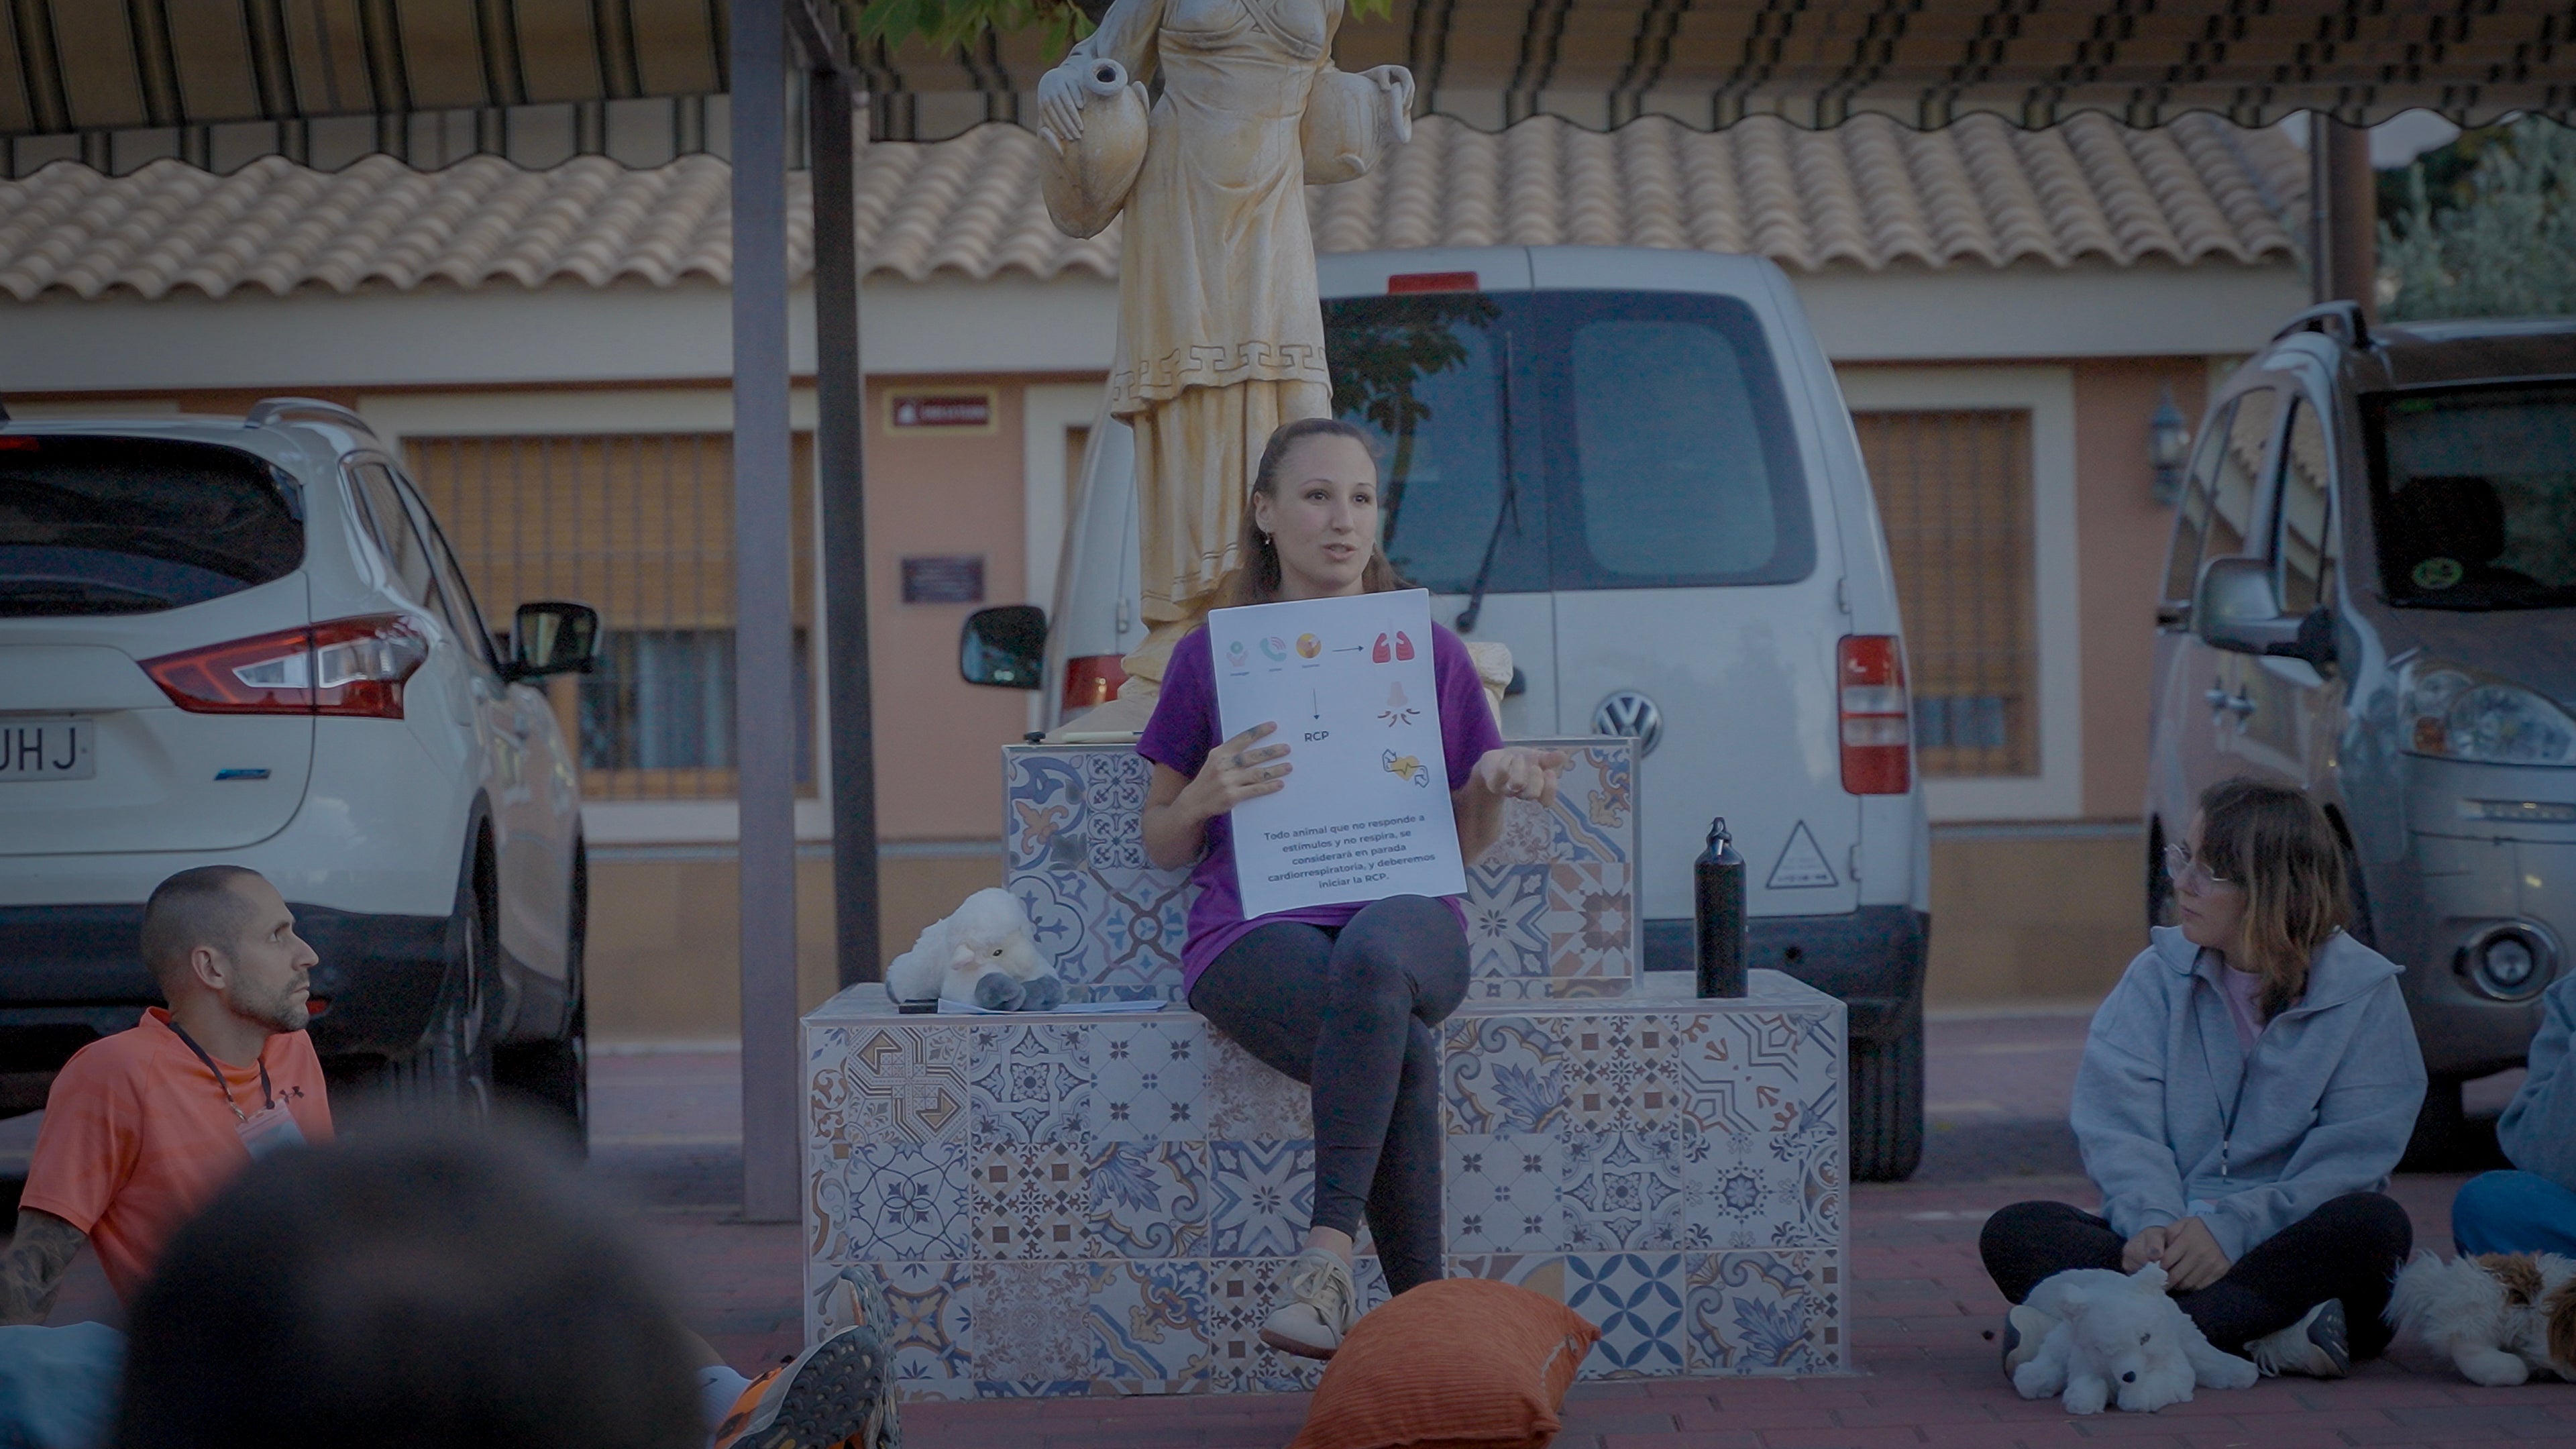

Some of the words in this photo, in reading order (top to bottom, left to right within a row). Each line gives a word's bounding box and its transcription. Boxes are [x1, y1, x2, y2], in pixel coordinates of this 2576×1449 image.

[1305, 731, 1329, 742] RCP
[1264, 831, 1290, 840] Todo
[1293, 826, 1327, 837] animal
[1330, 825, 1349, 834] que
[1368, 816, 1415, 827] responde
[1360, 832, 1397, 843] respira,
[1371, 845, 1406, 856] parada
[1377, 855, 1435, 867] deberemos
[1319, 877, 1350, 888] iniciar
[1366, 873, 1389, 882] RCP.
